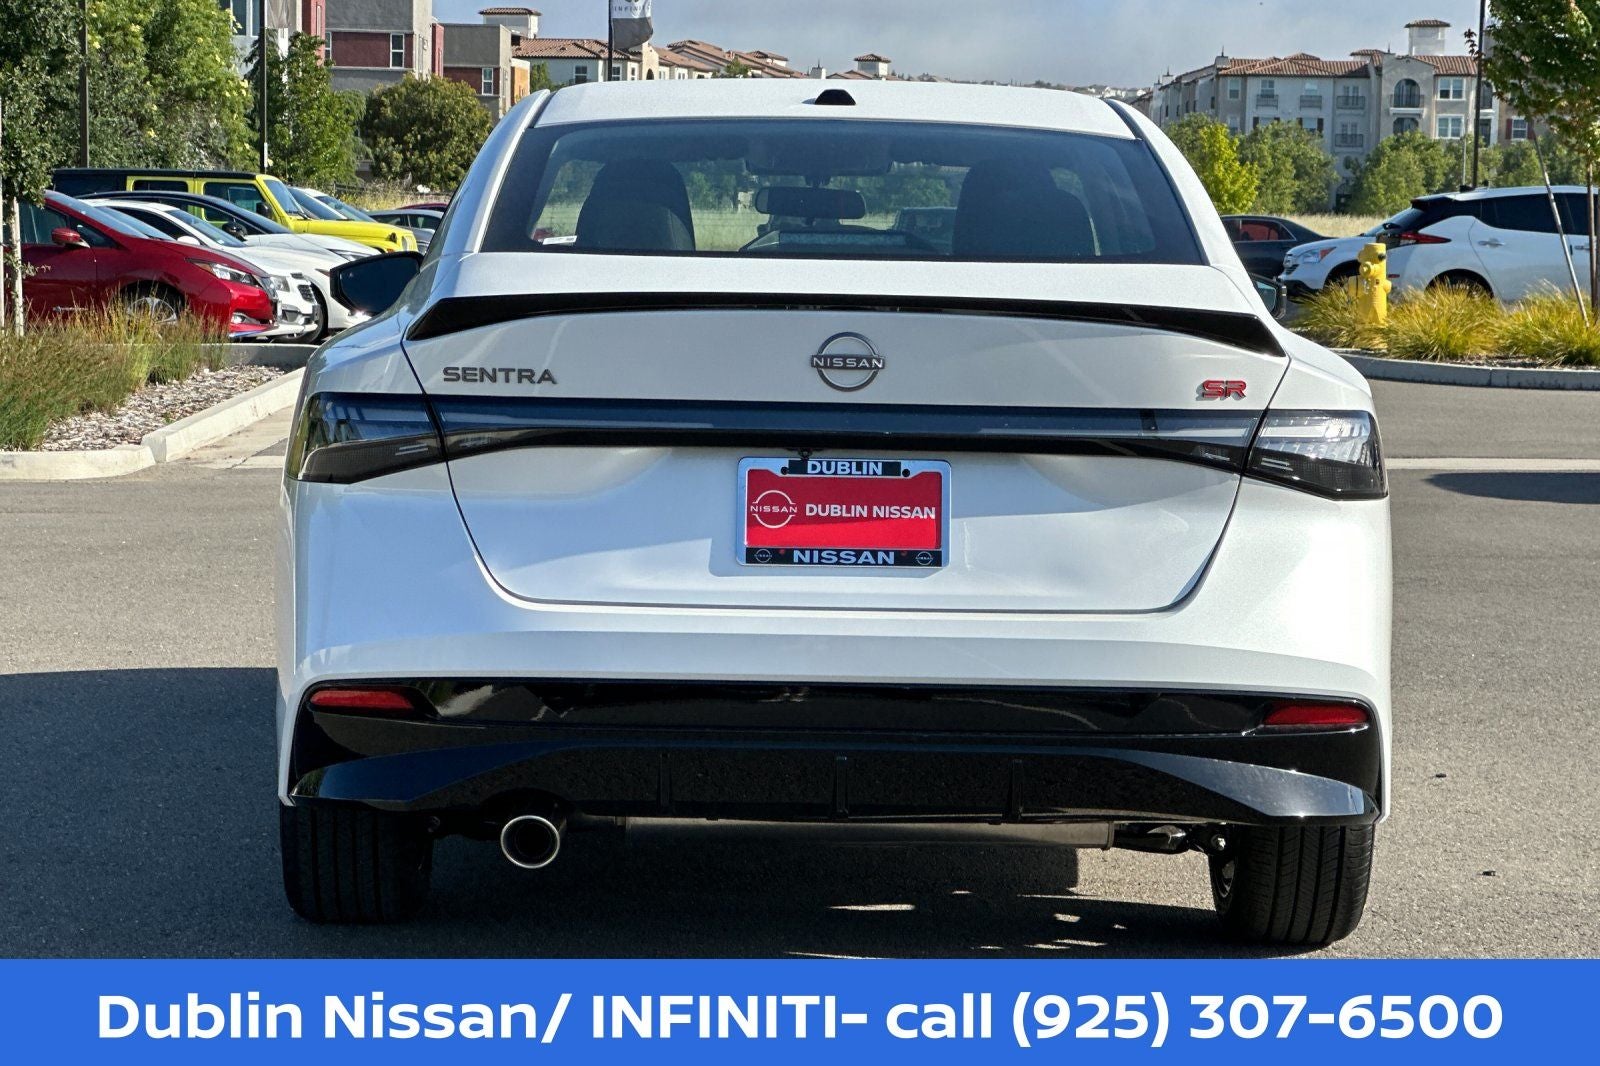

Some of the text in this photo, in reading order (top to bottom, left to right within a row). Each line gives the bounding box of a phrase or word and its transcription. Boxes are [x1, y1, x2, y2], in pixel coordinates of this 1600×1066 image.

[813, 357, 883, 368] NISSAN
[443, 366, 558, 384] SENTRA
[1202, 380, 1247, 398] SR
[807, 461, 882, 476] DUBLIN
[750, 505, 797, 513] NISSAN
[805, 504, 936, 519] DUBLIN NISSAN
[793, 550, 895, 565] NISSAN
